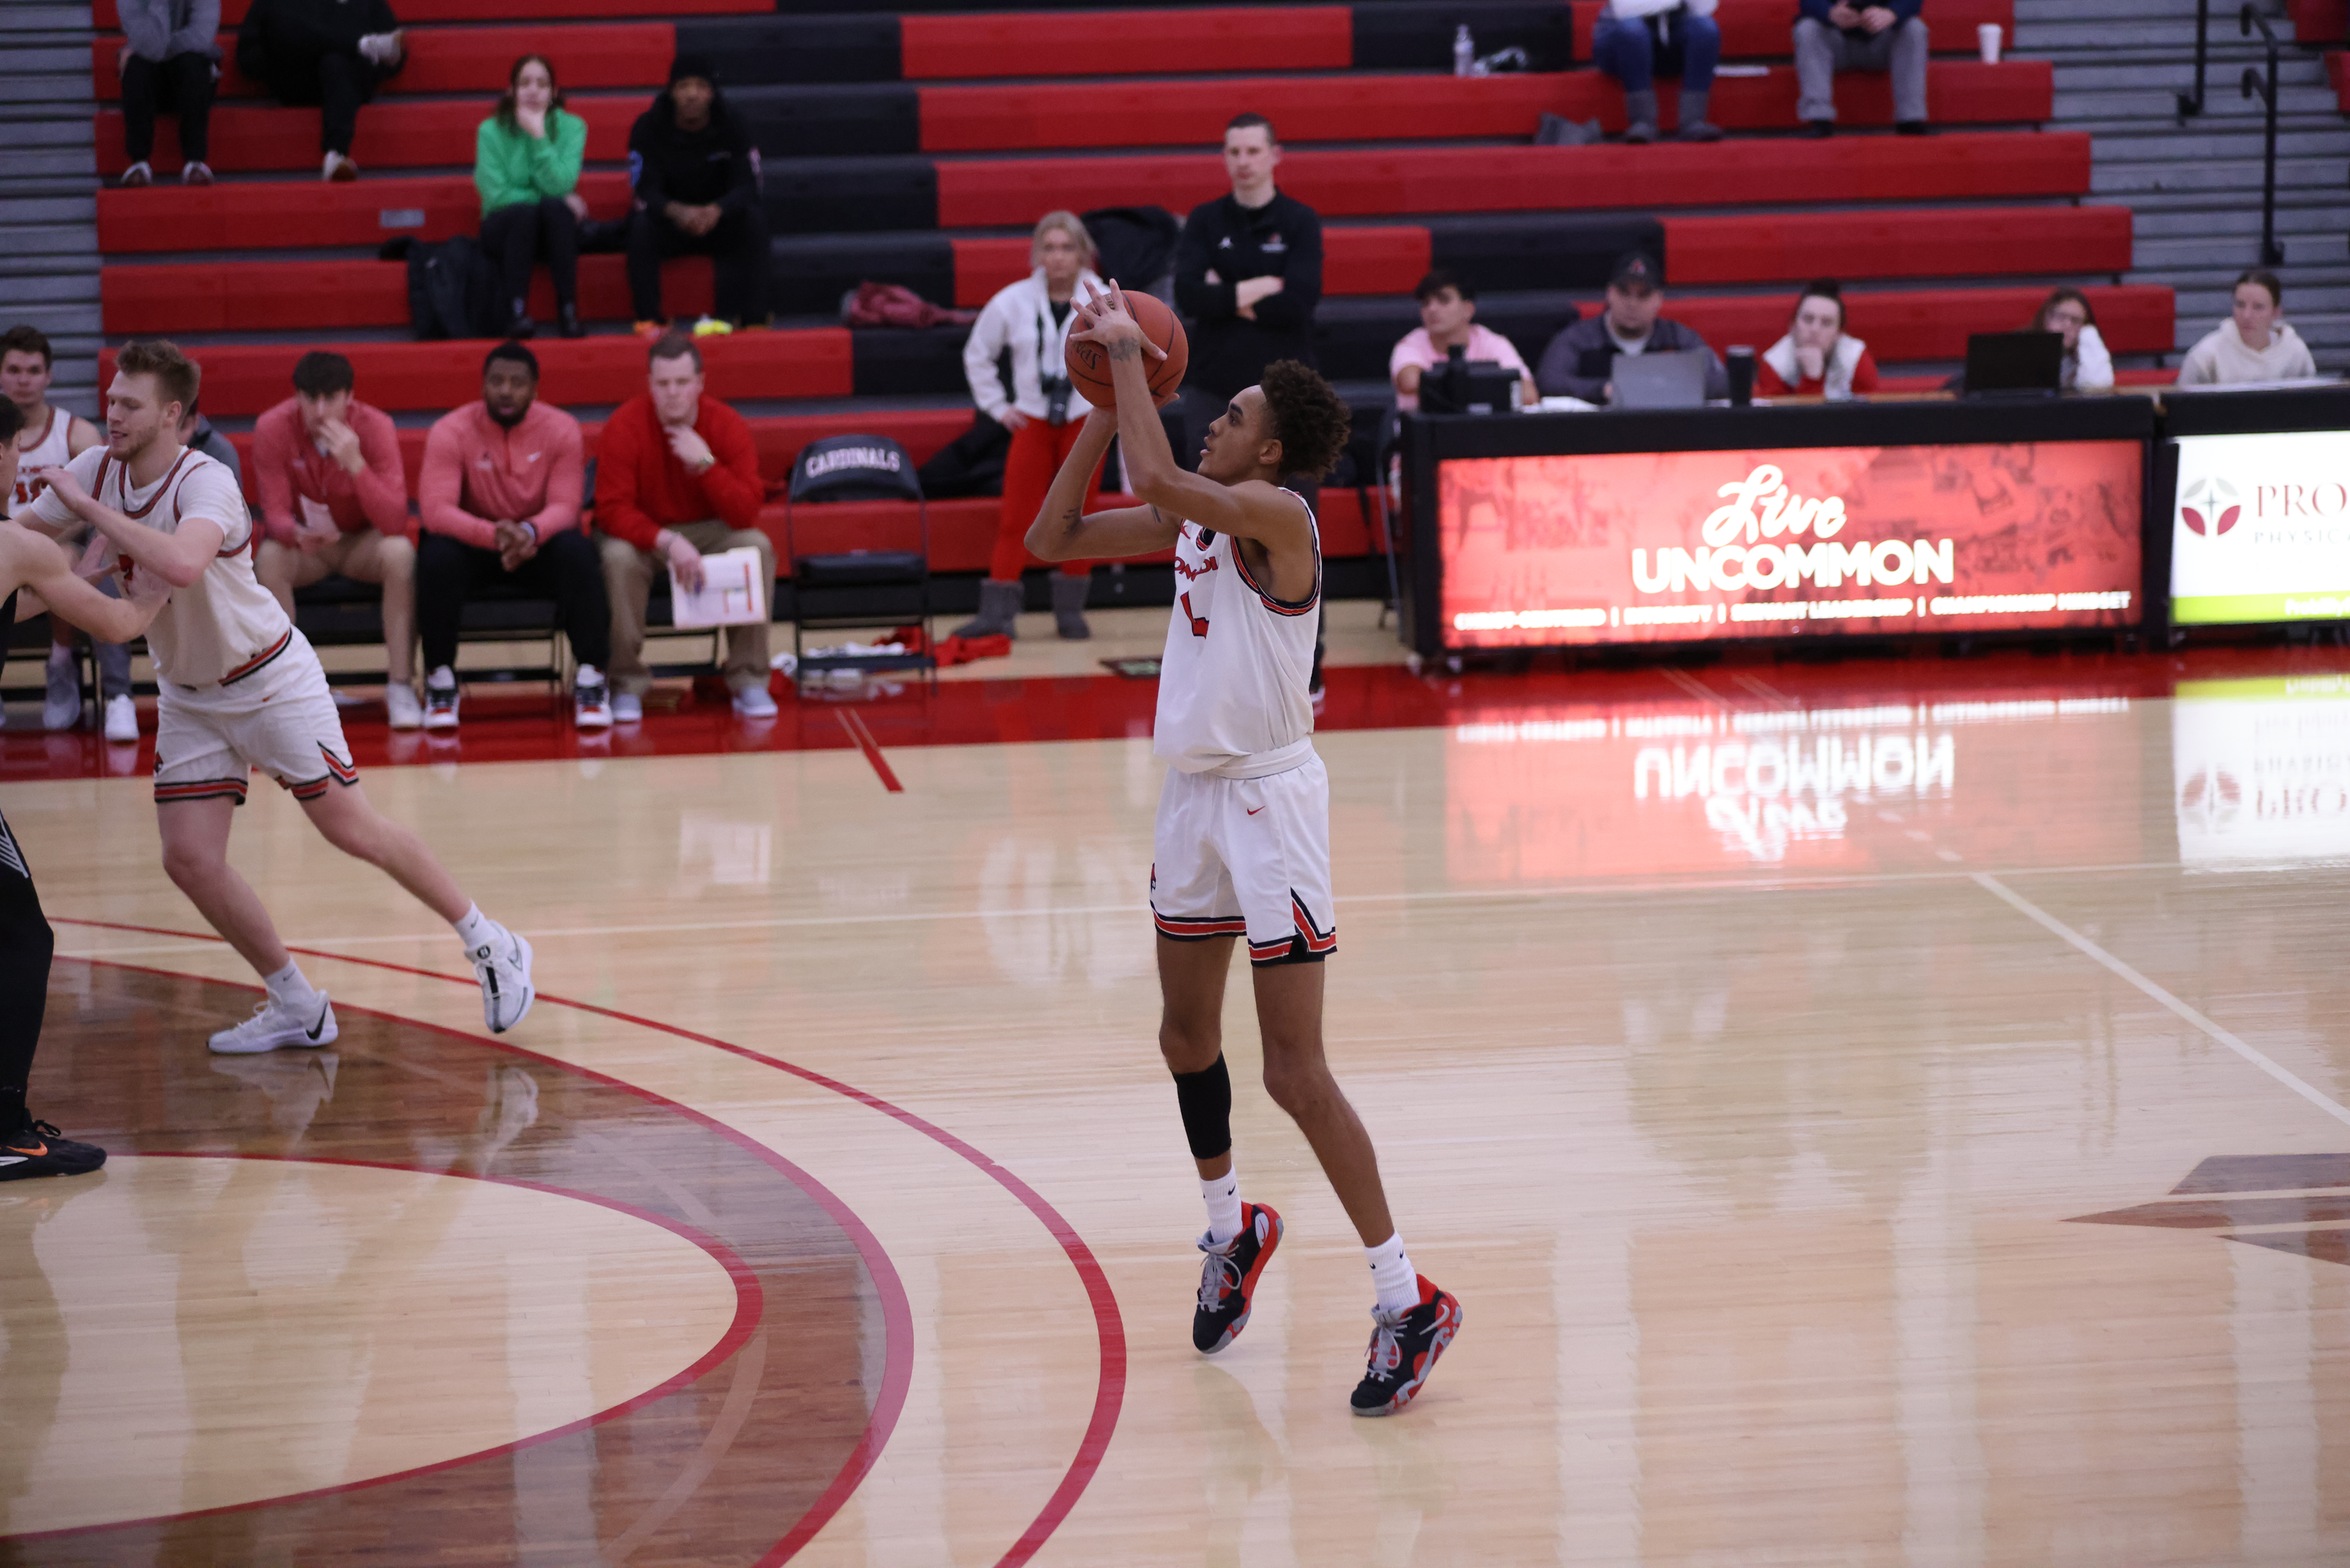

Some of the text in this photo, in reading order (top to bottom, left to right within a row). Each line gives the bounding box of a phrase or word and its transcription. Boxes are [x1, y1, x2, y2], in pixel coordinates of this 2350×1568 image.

[805, 446, 900, 478] CARDINALS
[1702, 465, 1847, 547] Live
[2254, 530, 2350, 545] PHYSIC
[1632, 538, 1954, 593] UNCOMMON
